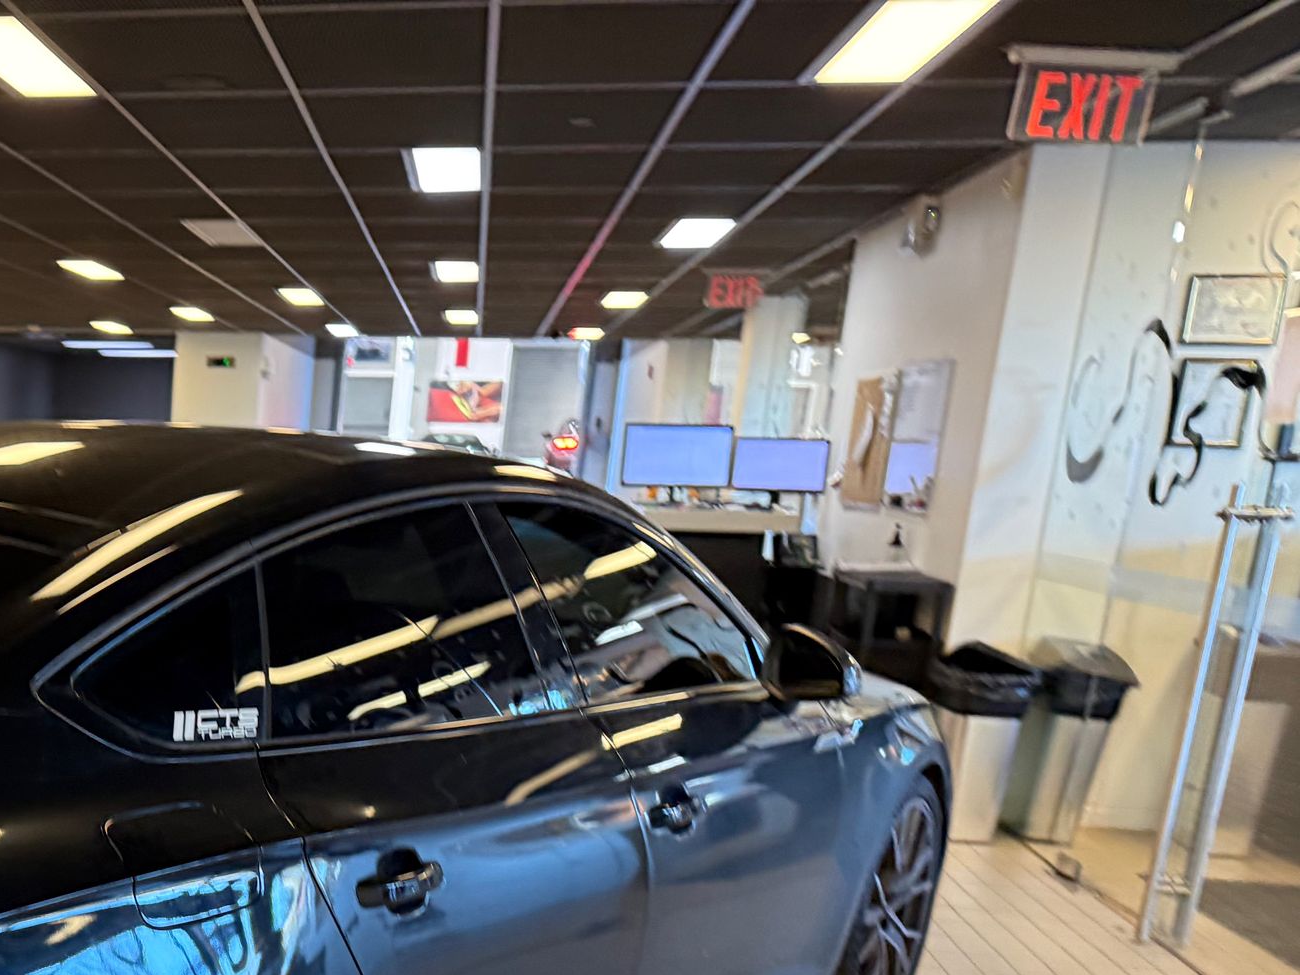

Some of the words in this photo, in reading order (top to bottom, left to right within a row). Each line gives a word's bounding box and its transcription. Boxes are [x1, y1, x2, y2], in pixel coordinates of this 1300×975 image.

[1025, 70, 1144, 143] EXIT
[197, 707, 259, 730] CTS
[197, 726, 258, 740] TURBO
